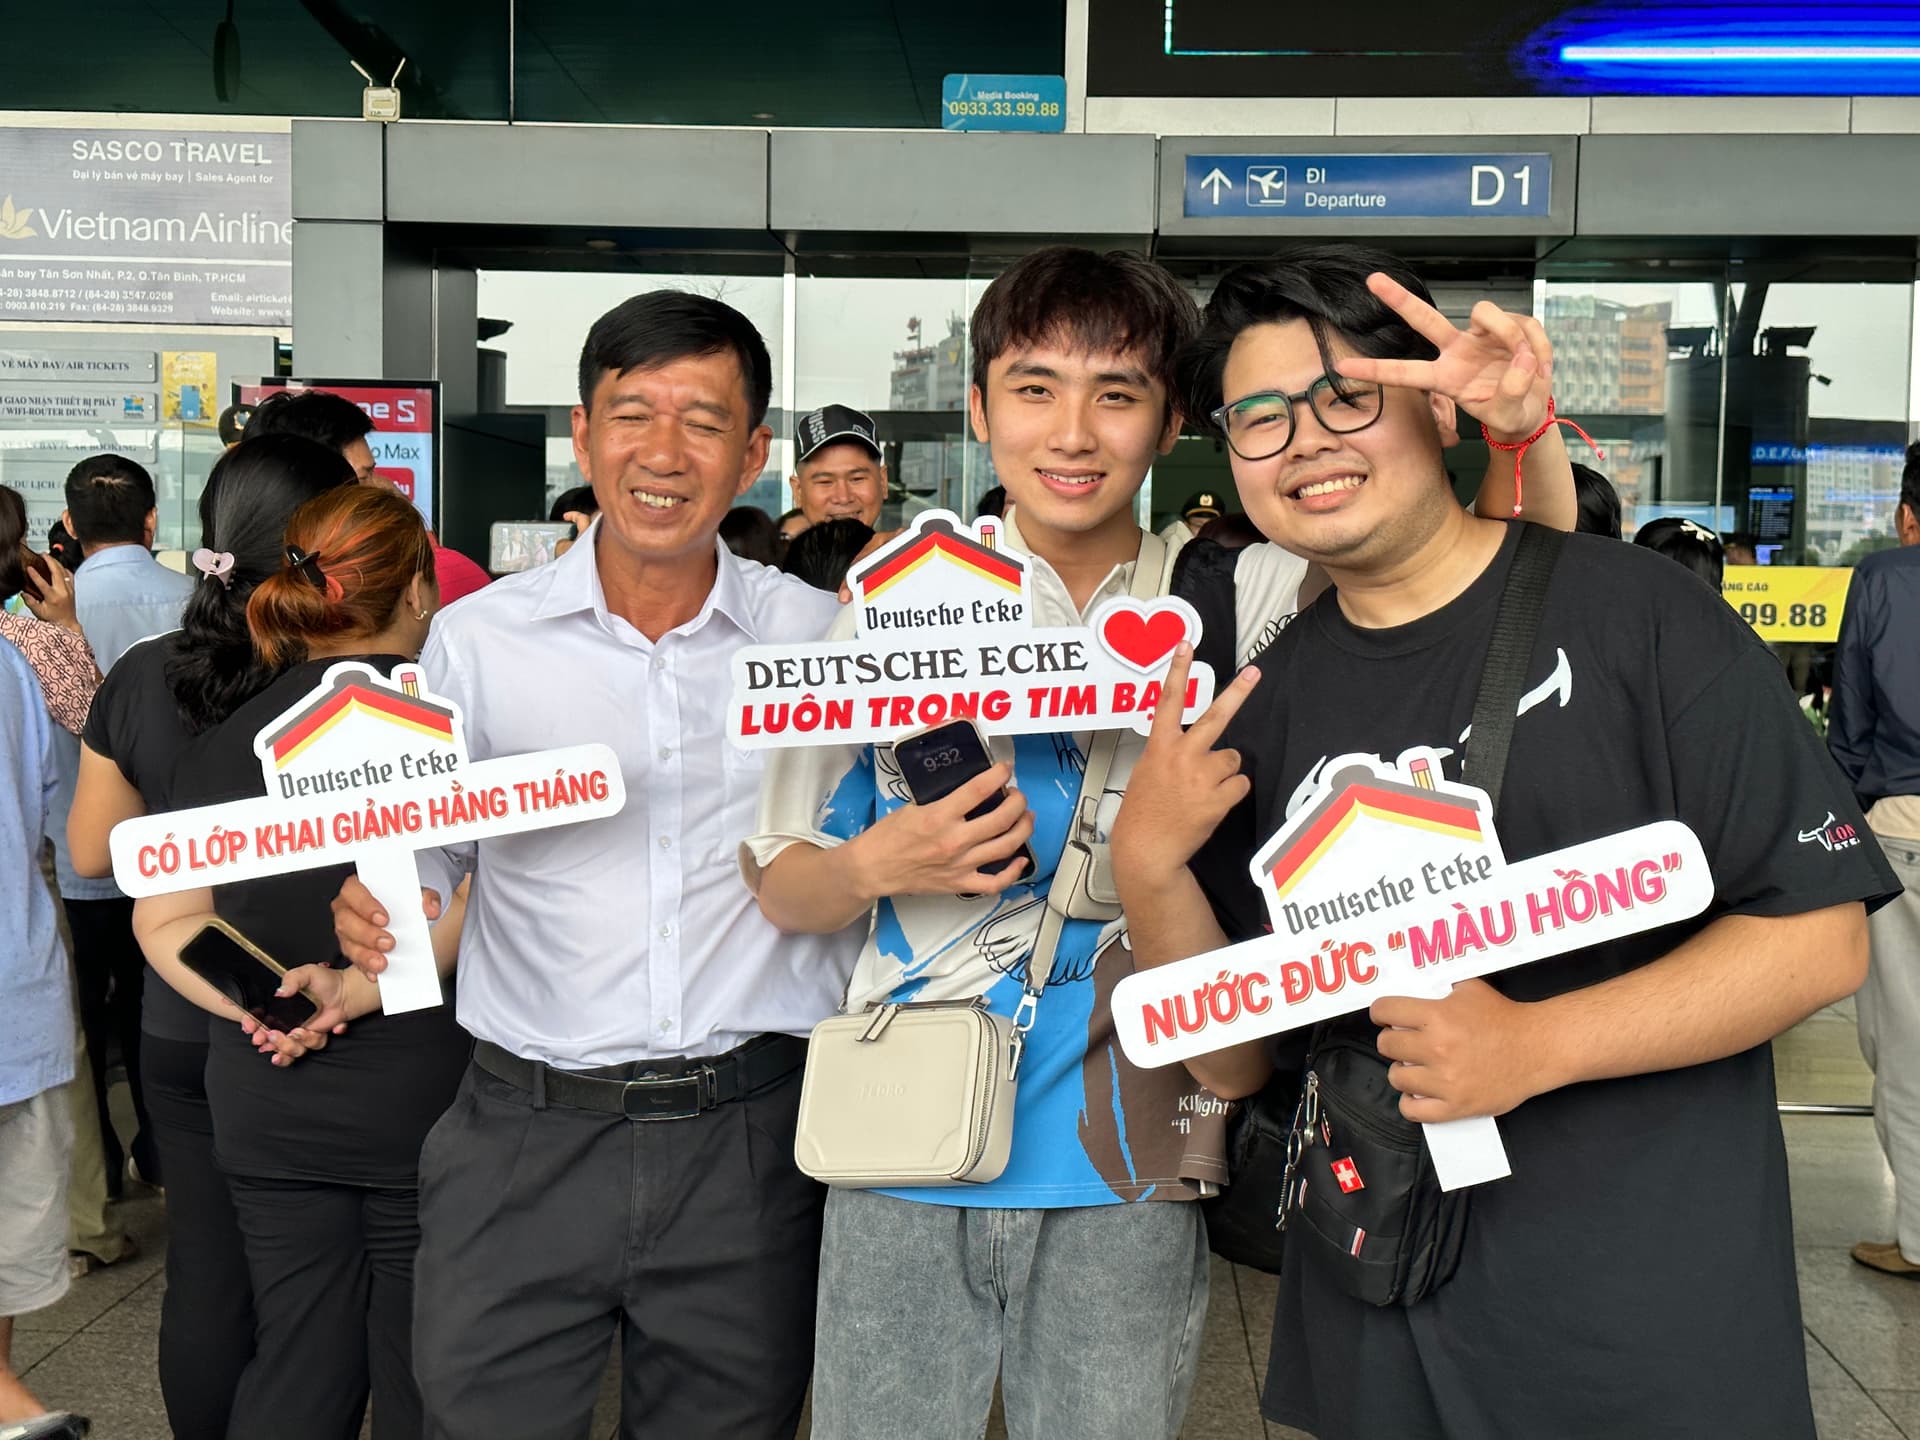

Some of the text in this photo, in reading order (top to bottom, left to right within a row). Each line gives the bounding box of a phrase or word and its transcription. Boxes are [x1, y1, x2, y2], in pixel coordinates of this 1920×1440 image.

[949, 101, 1059, 116] 0933.33.99.88
[72, 140, 273, 165] SASCO TRAVEL
[141, 171, 162, 184] máy
[165, 172, 184, 183] bay
[195, 172, 224, 183] Sales
[226, 173, 256, 184] Agent
[259, 174, 274, 184] for
[1305, 168, 1326, 184] ĐI
[1470, 165, 1533, 206] D1
[1304, 193, 1387, 210] Departure
[38, 207, 186, 242] Vietnam
[17, 269, 37, 281] bay
[67, 361, 85, 370] AIR
[86, 361, 131, 372] TICKETS
[66, 407, 98, 417] DEVICE
[384, 443, 421, 460] Max
[865, 598, 1024, 631] Deutsche Ecke
[745, 640, 1089, 690] DEUTSCHE ECKE
[740, 694, 855, 736] LUÔN
[867, 689, 1012, 728] TRONG
[1027, 684, 1097, 720] TIM
[923, 747, 963, 773] 9:32
[278, 750, 459, 800] Deutsche Ecke
[138, 769, 609, 878] CÓ LỚP KHAI GIẢNG HẰNG THÁNG
[1282, 852, 1493, 936] Deutsche Ecke
[1141, 969, 1271, 1044] NƯỚC
[1280, 940, 1379, 1004] ĐỨC
